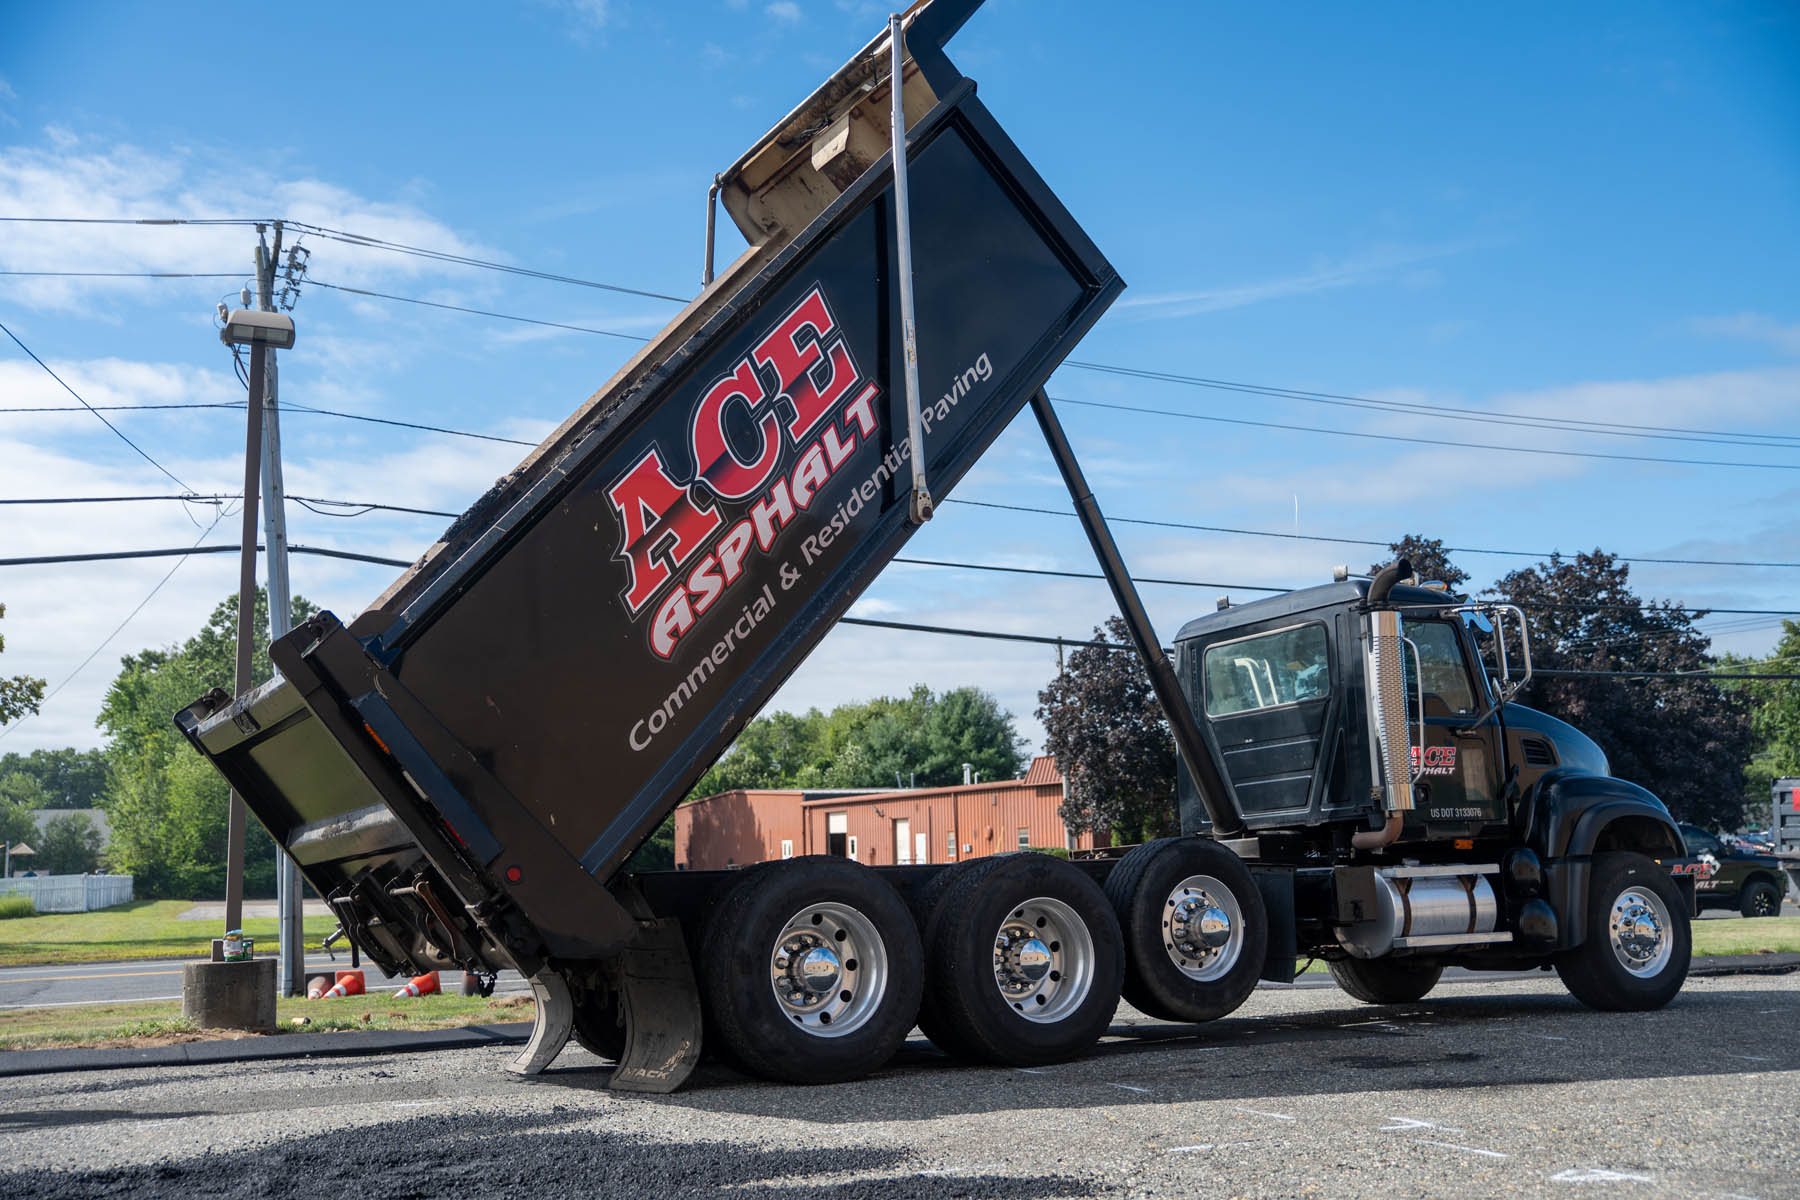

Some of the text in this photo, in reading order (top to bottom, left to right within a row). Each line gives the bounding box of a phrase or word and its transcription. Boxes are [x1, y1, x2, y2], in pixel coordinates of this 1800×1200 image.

[609, 288, 860, 614] ACE
[650, 383, 881, 658] ASPHALT
[629, 352, 993, 752] Commercial & Residentia Paving
[1411, 767, 1455, 775] SHALT
[1430, 808, 1440, 818] US
[1441, 808, 1454, 818] DOT
[623, 1067, 670, 1080] MACK
